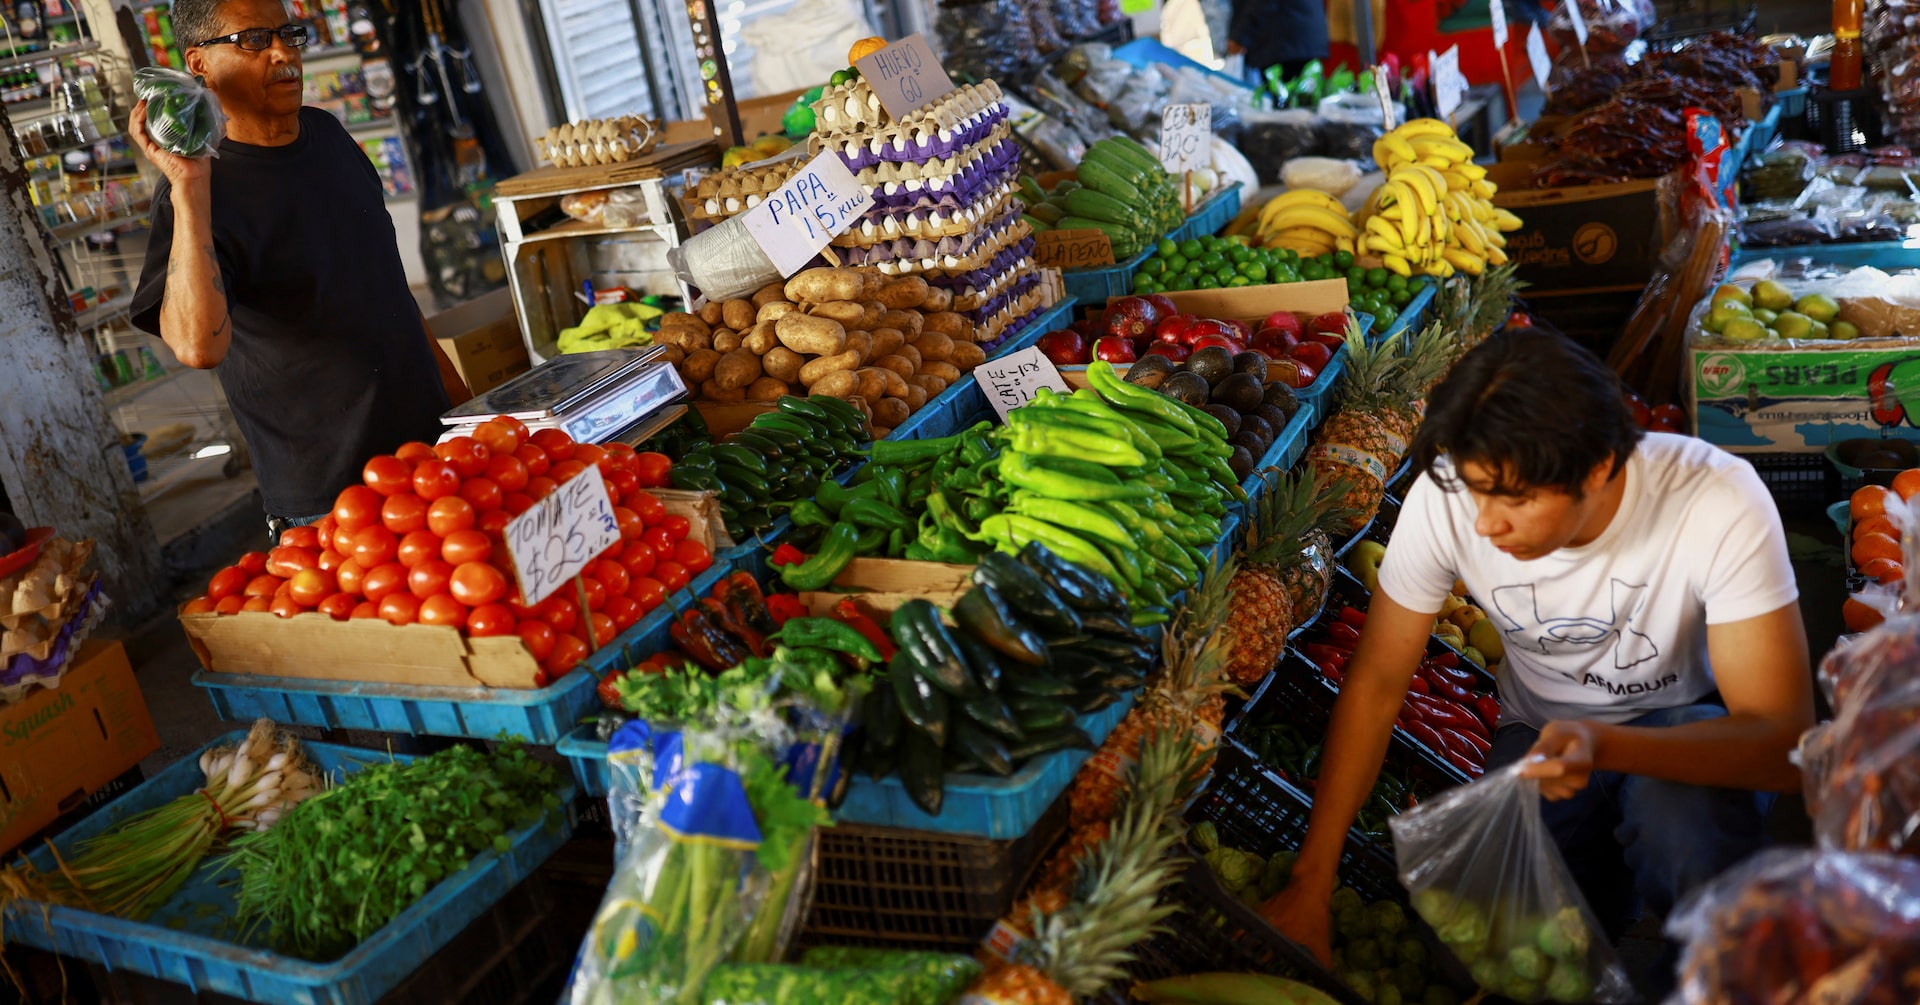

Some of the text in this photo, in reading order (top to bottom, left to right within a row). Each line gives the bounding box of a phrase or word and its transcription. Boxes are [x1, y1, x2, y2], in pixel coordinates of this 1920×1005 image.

[874, 43, 922, 80] HUEVO
[768, 172, 827, 225] PAPA
[838, 191, 865, 220] KILO
[1768, 365, 1857, 386] PEARS
[509, 472, 594, 554] TOMATE
[1583, 673, 1678, 695] ARMOUR
[3, 691, 75, 747] Squash
